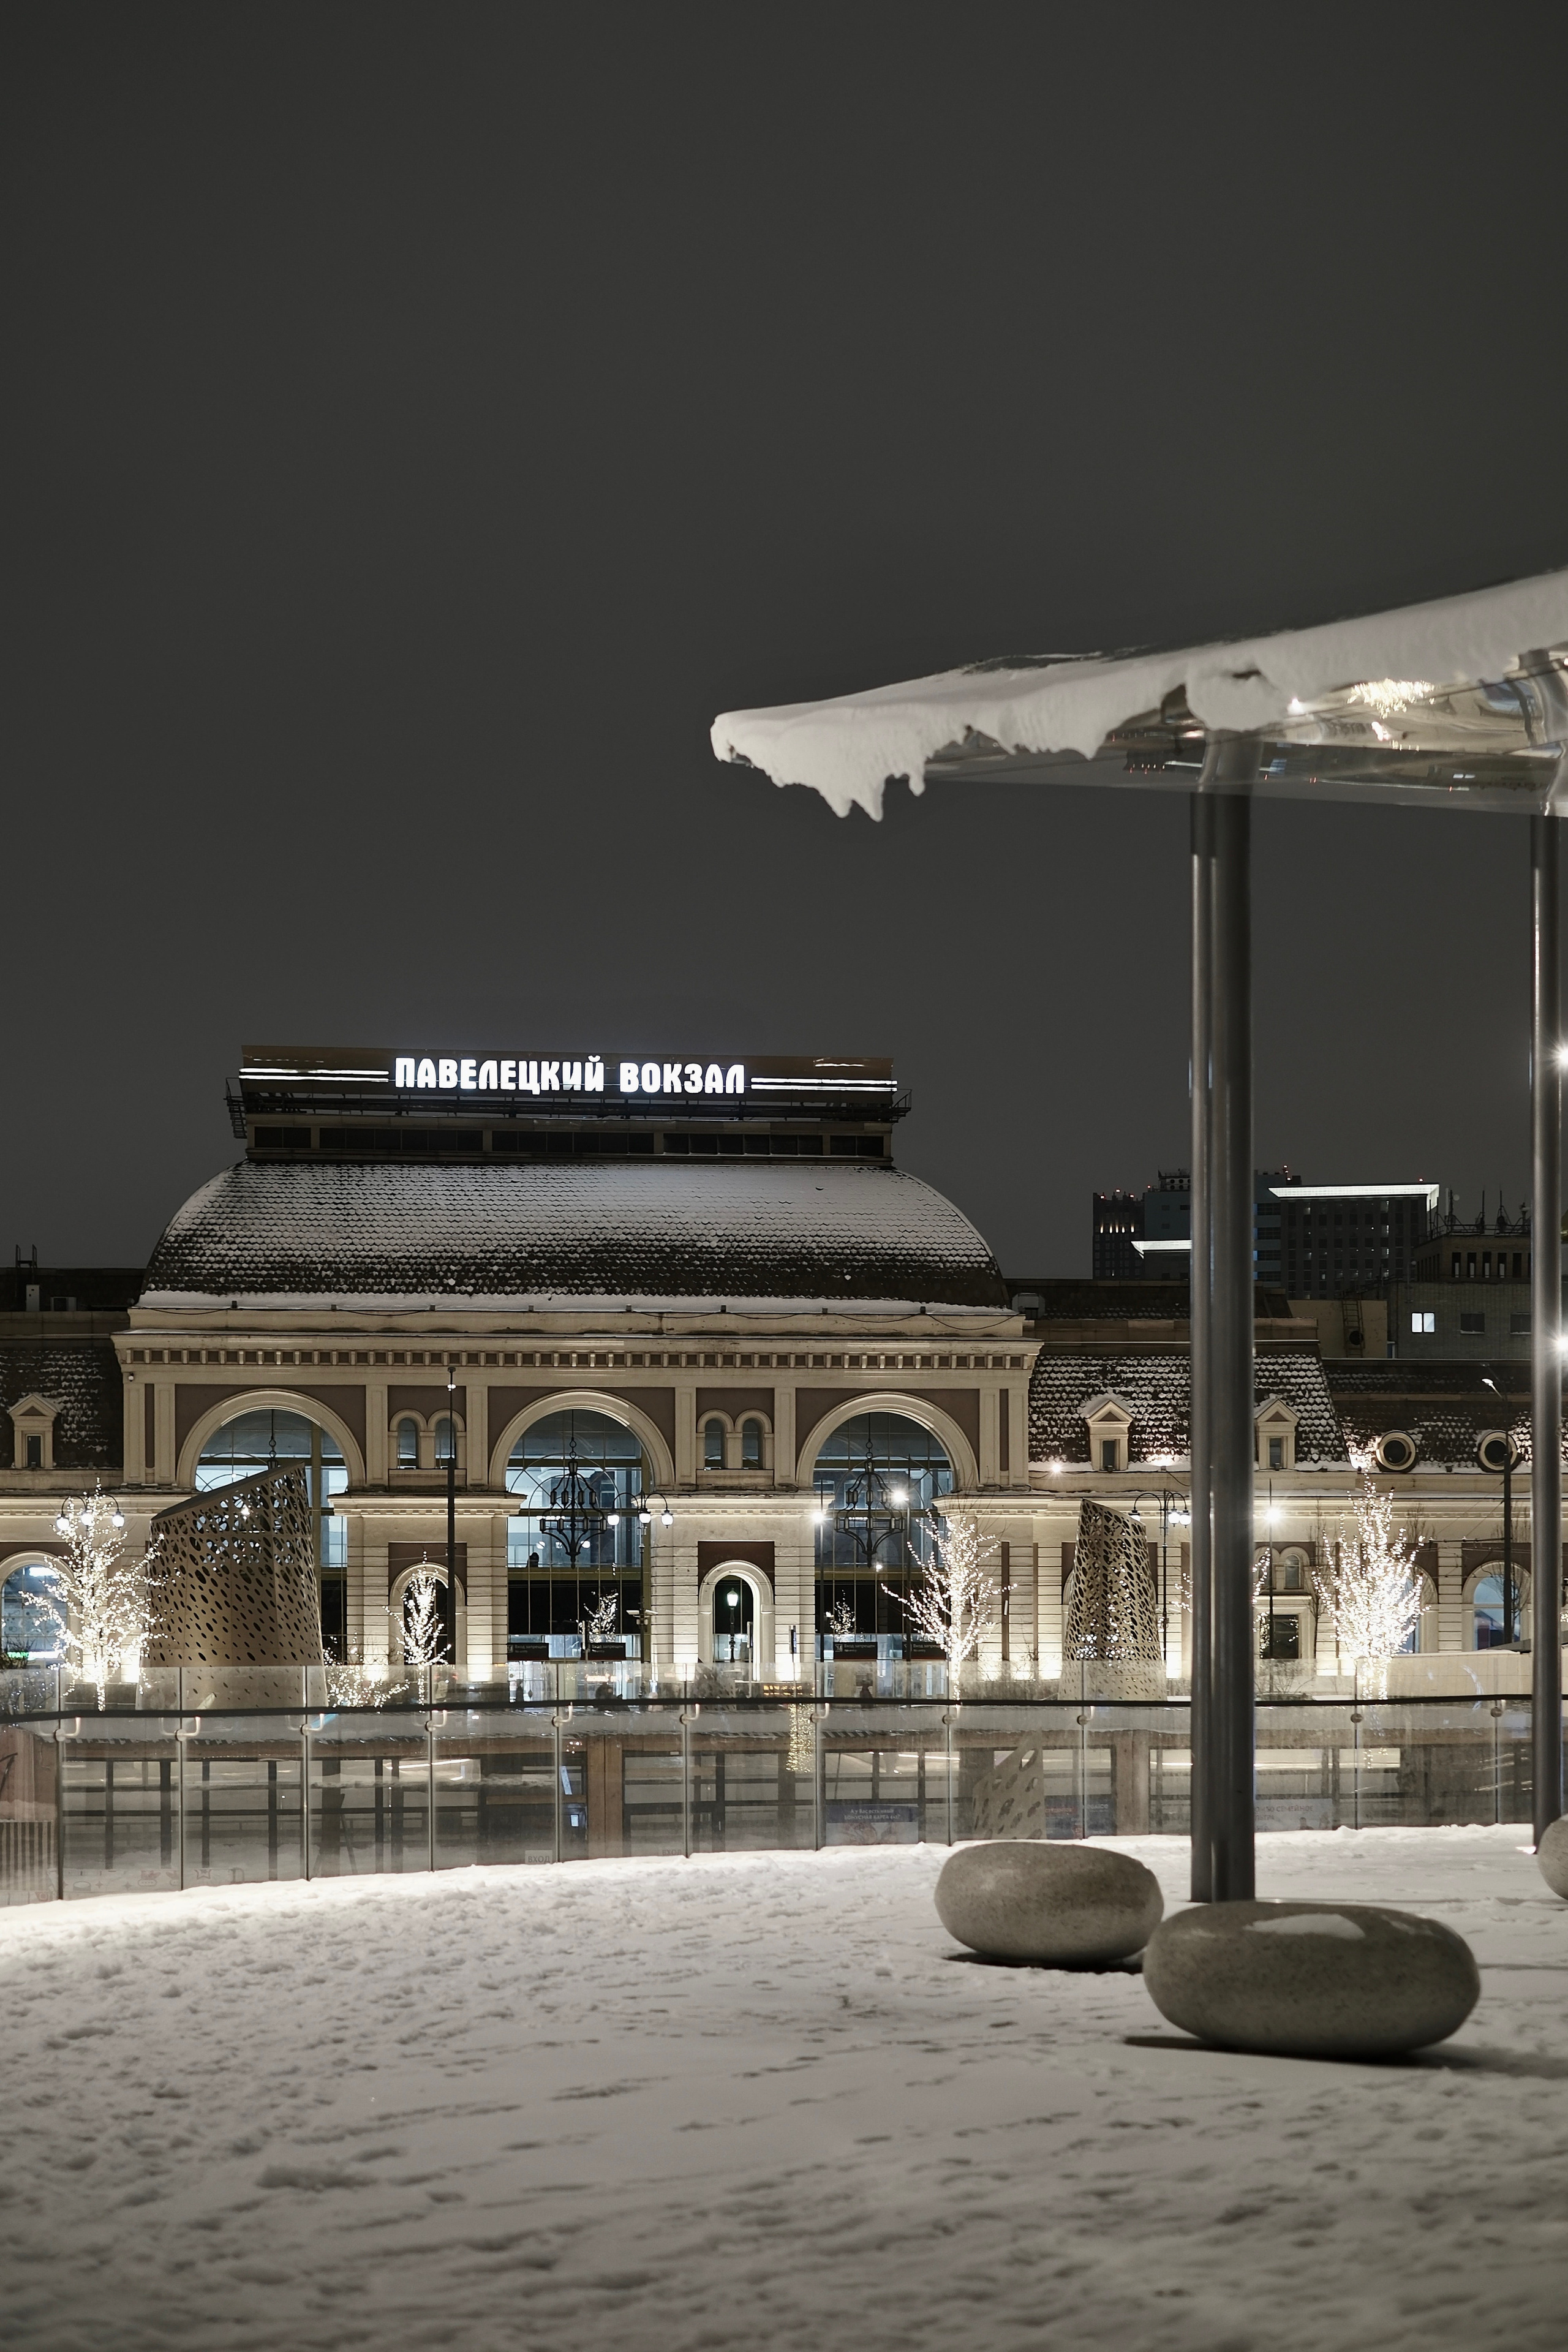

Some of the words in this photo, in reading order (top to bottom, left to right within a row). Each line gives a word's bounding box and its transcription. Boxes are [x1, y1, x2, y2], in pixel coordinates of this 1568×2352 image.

[395, 1055, 604, 1095] ПАВЕЛЕЦКИЙ
[619, 1062, 745, 1094] ВОКЗАЛ
[528, 1856, 550, 1864] ВХОД
